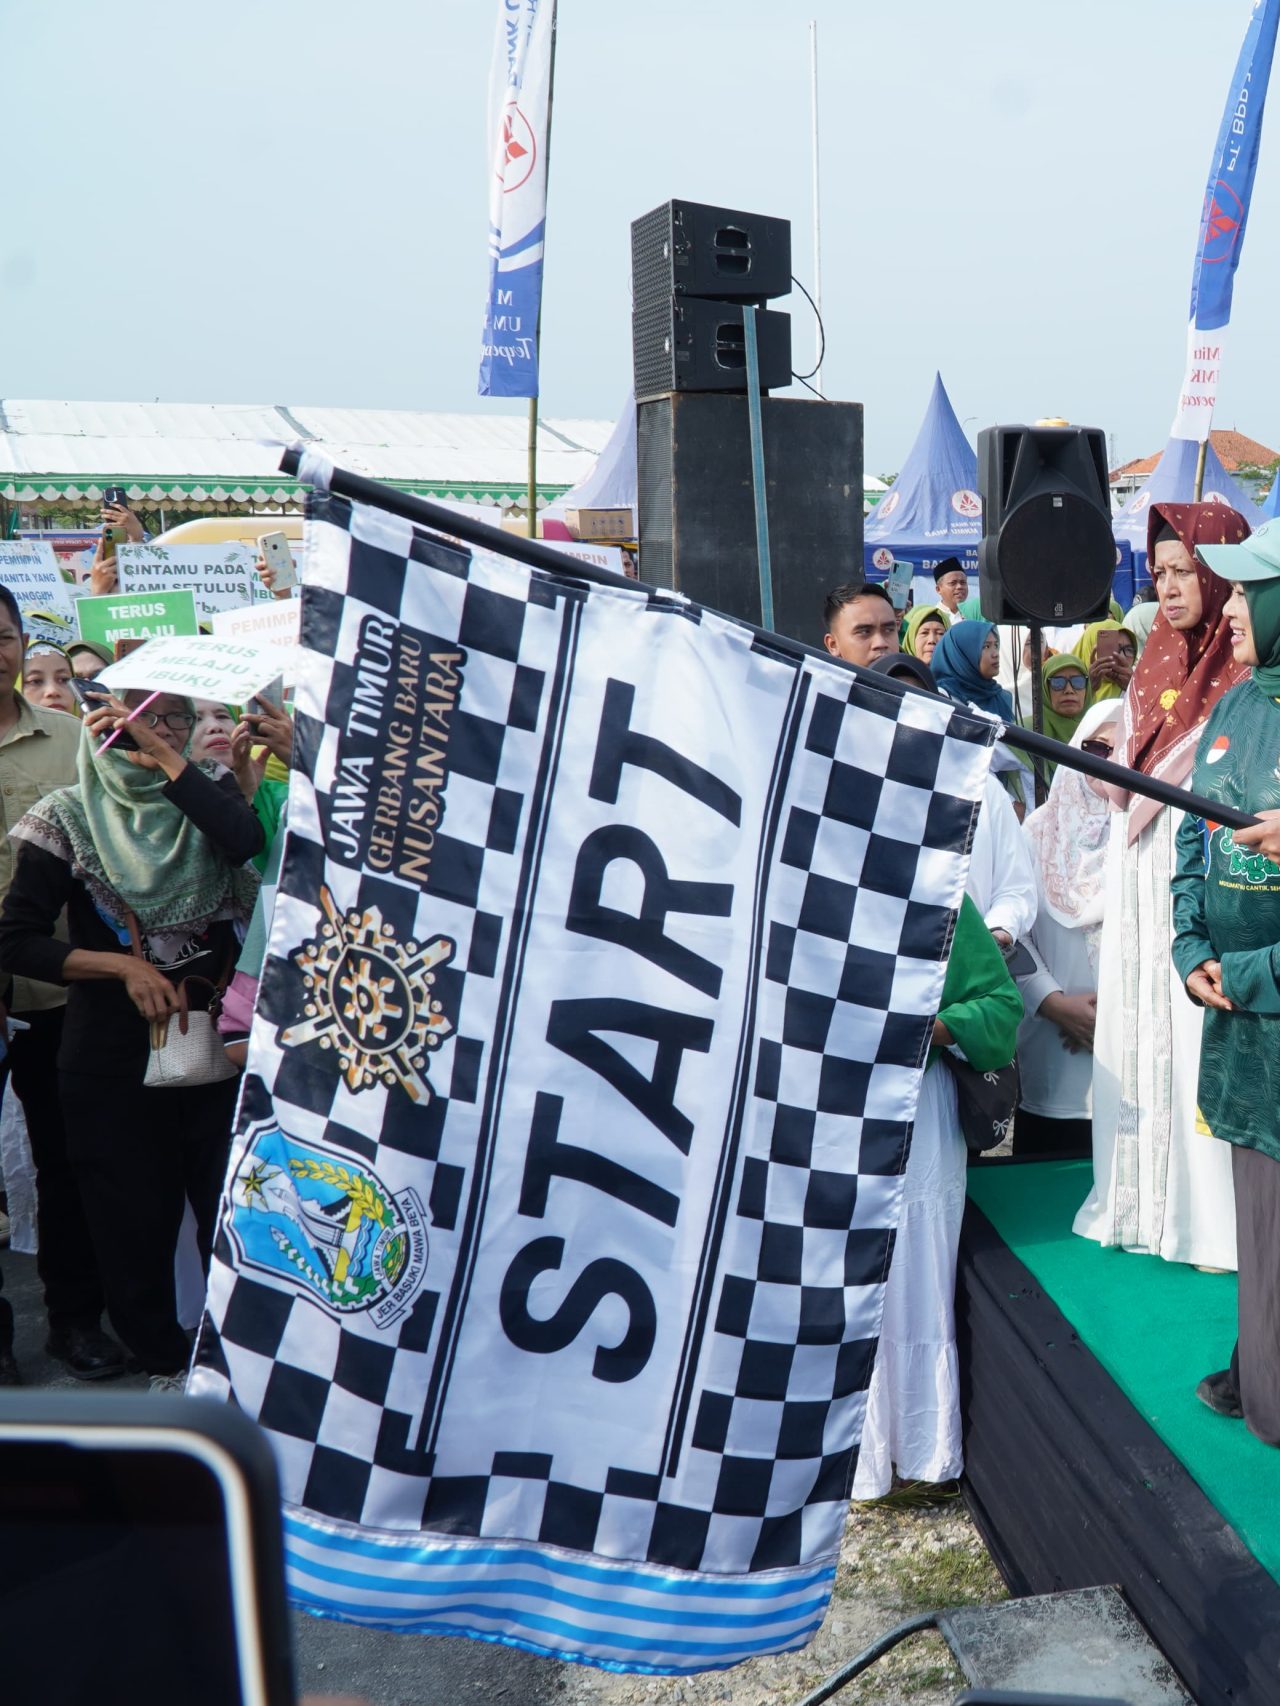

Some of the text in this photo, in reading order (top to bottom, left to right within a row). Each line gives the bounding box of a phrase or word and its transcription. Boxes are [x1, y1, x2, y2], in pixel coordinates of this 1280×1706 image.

[32, 573, 56, 583] YANG
[124, 564, 246, 576] CINTAMU PADA
[107, 602, 166, 619] TERUS
[104, 624, 175, 643] MELAJU
[185, 641, 260, 659] TERUS
[157, 656, 250, 675] MELAJU
[146, 670, 222, 689] IBUKU
[329, 617, 396, 860] JAWA TIMUR
[366, 633, 422, 869] GERBANG BARU
[399, 652, 462, 883] NUSANTARA
[499, 676, 743, 1384] START
[373, 1230, 393, 1278] JAWA TIMUR
[376, 1196, 425, 1320] JER BASUKI MAWA BEYA
